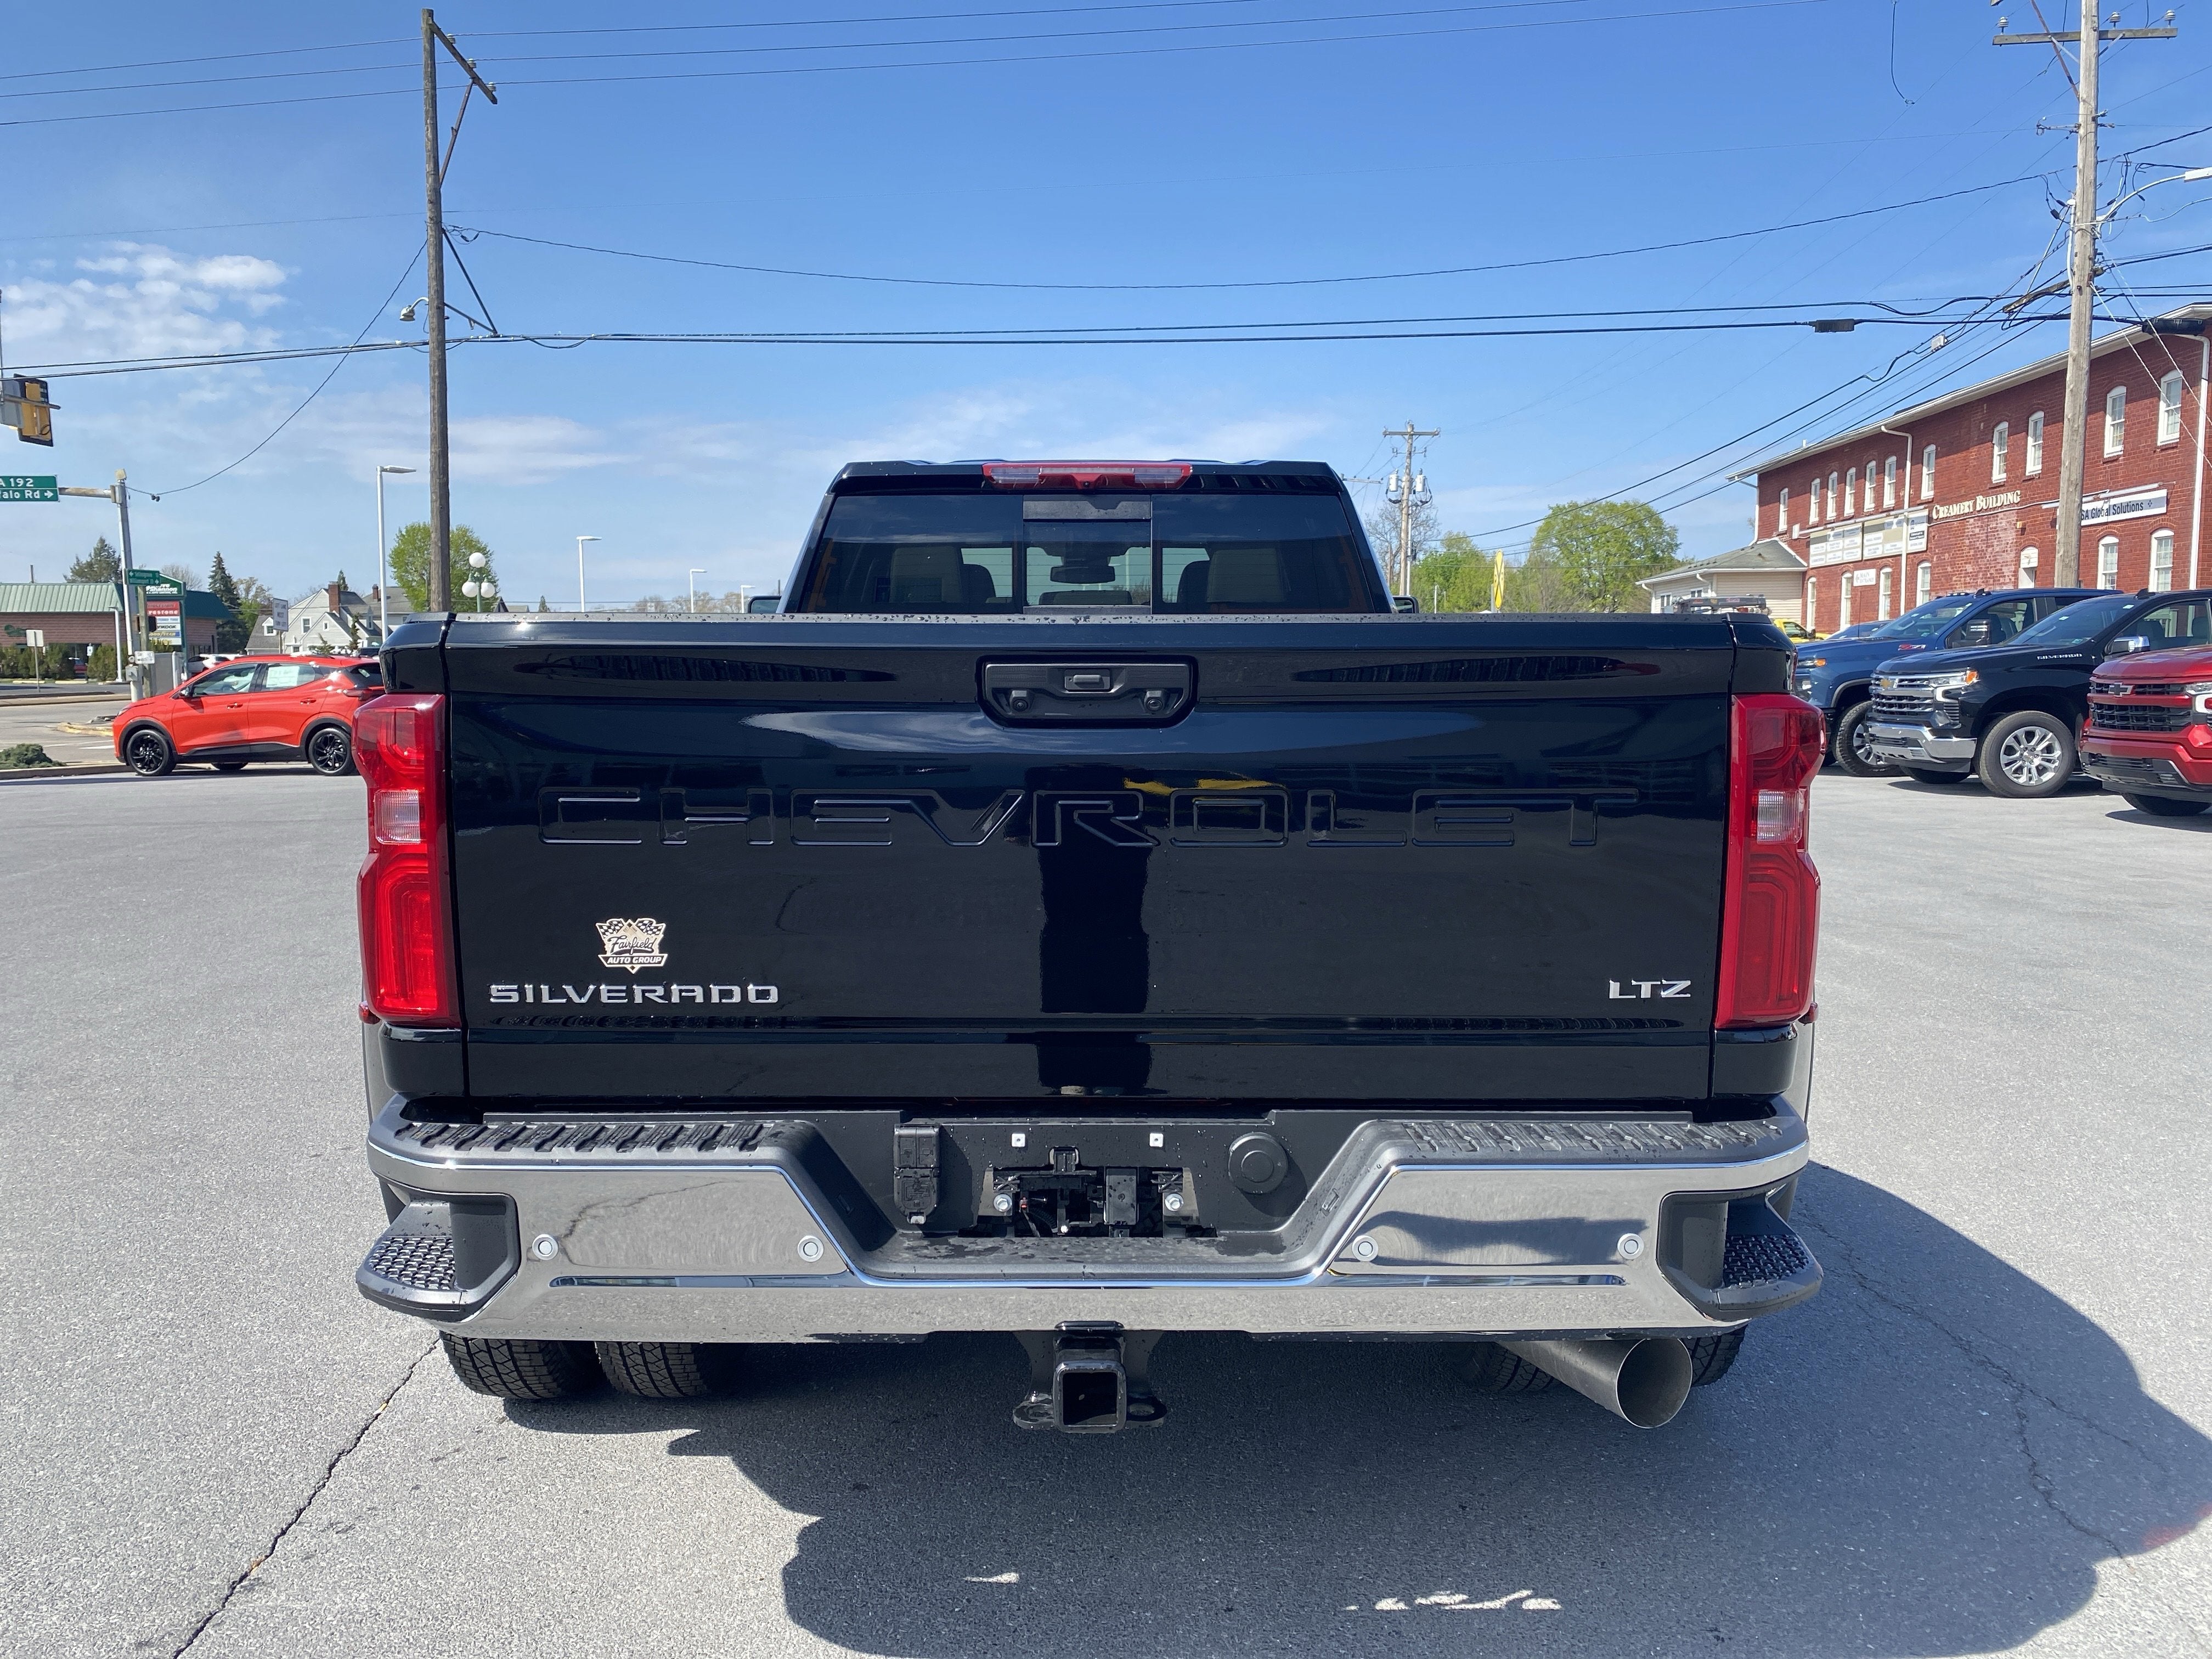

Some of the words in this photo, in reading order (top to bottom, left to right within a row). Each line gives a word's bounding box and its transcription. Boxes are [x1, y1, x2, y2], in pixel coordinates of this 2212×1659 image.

[10, 478, 33, 487] 192
[0, 490, 20, 499] alo
[25, 490, 40, 499] Rd
[1976, 490, 2021, 511] BUILDING
[2091, 506, 2111, 519] Global
[2113, 501, 2143, 515] Solutions
[539, 787, 1640, 848] CHEVROLET
[607, 935, 657, 955] Fairfield
[489, 984, 778, 1004] SILVERADO
[1609, 979, 1691, 999] LTZ
